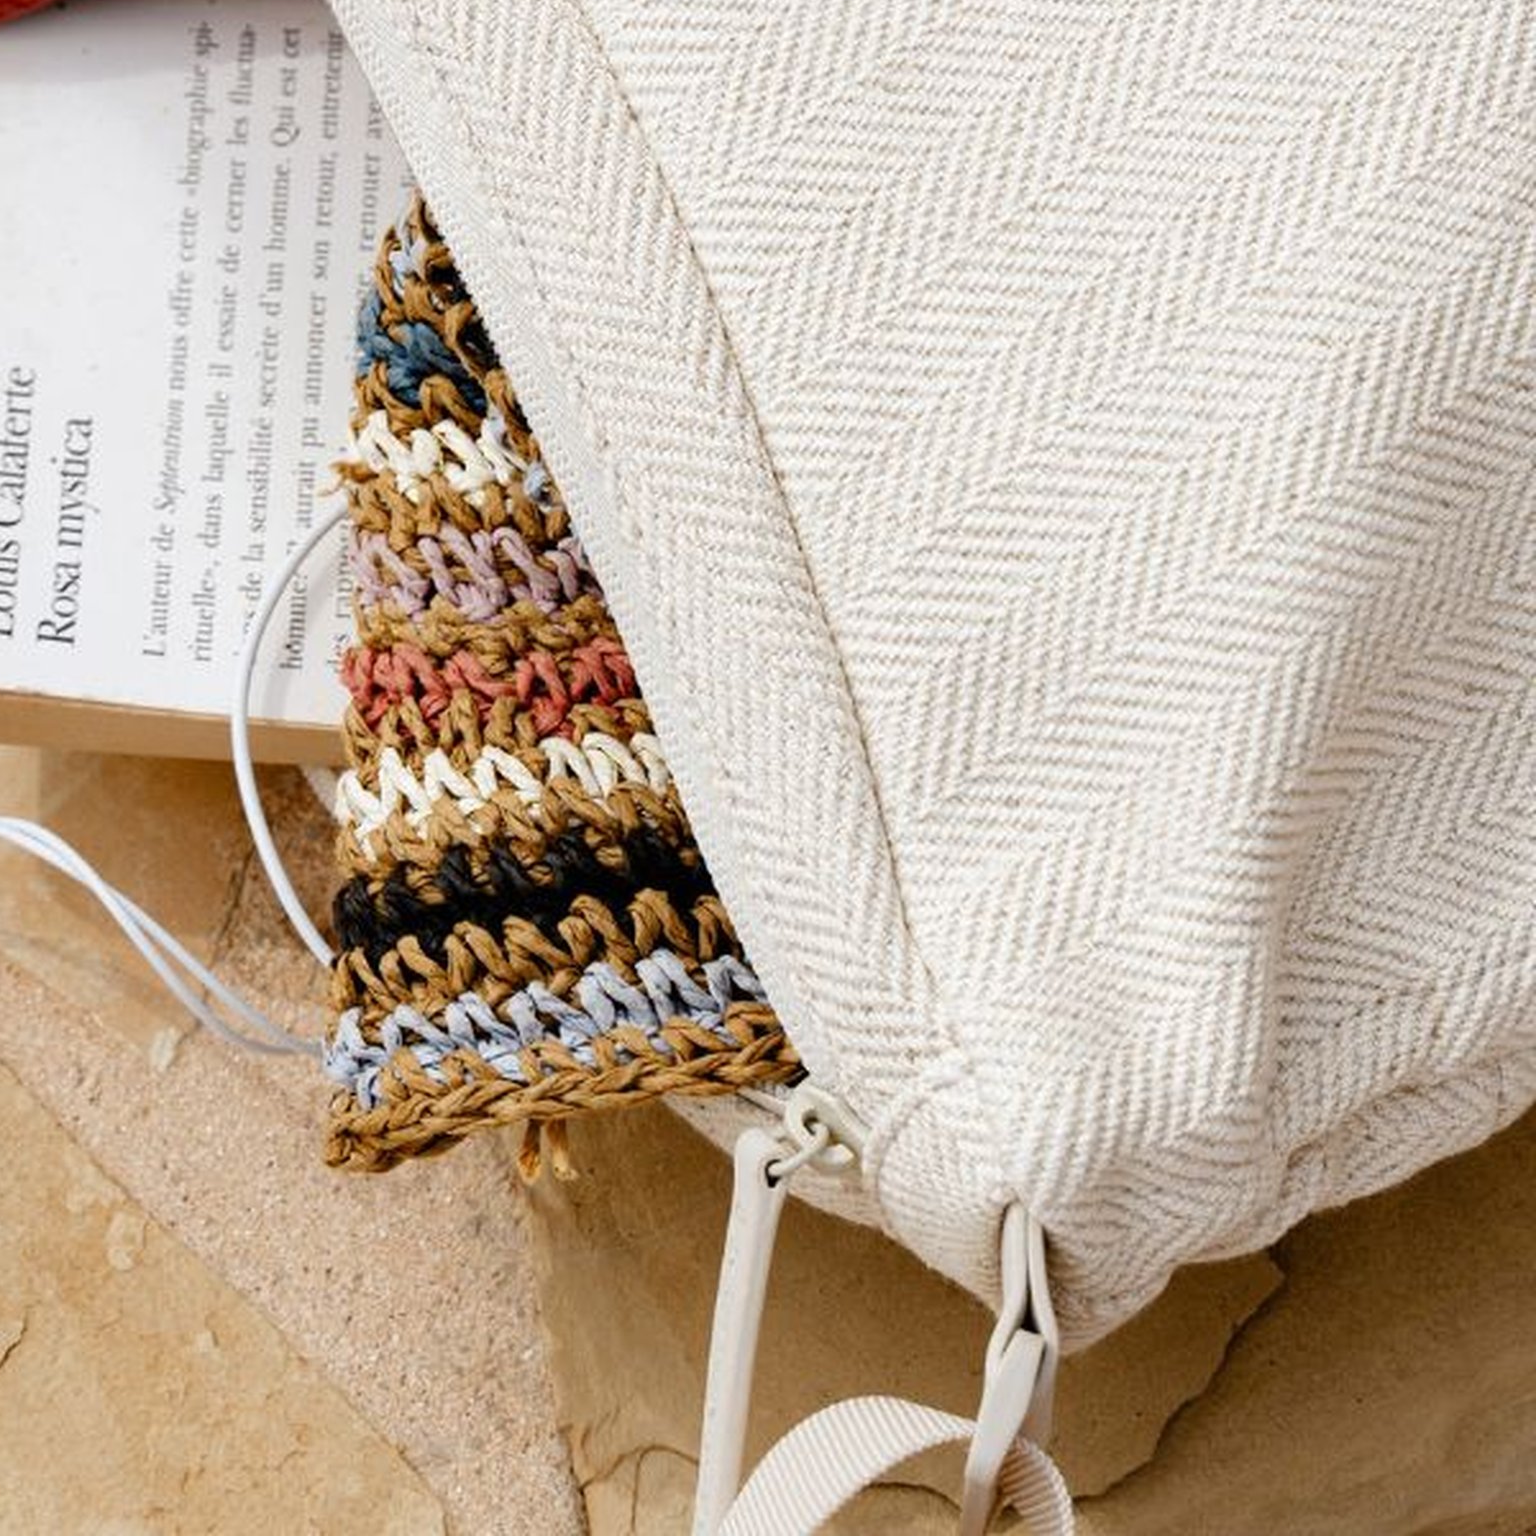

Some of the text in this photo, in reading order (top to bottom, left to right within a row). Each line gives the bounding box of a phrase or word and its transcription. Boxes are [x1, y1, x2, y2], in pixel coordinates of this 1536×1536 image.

[186, 20, 220, 57] spi-
[228, 21, 257, 106] fluctua-
[279, 26, 301, 60] cet
[275, 66, 298, 98] est
[318, 28, 343, 141] entretenir
[225, 115, 249, 146] les
[269, 104, 299, 148] Qui
[362, 94, 383, 140] ave
[223, 159, 247, 234] cerner
[262, 156, 291, 253] homme.
[313, 150, 340, 229] retour,
[359, 152, 383, 253] renouer
[178, 205, 199, 263] cette
[215, 244, 241, 274] de
[309, 239, 329, 281] son
[167, 270, 194, 327] offre
[257, 260, 284, 317] d'un
[214, 284, 239, 352] essaie
[168, 334, 188, 392] nous
[206, 363, 233, 378] il
[254, 325, 279, 408] secrète
[301, 292, 327, 406] annoncer
[154, 398, 185, 514] Septentrion
[201, 390, 234, 482] laquelle
[299, 415, 324, 448] pu
[242, 416, 272, 533] sensibilité
[289, 459, 316, 530] aurait
[36, 416, 99, 646] Rosa mystica
[149, 523, 174, 552] de
[195, 492, 223, 549] dans
[239, 543, 264, 562] la
[141, 561, 173, 658] L'auteur
[237, 571, 262, 602] de
